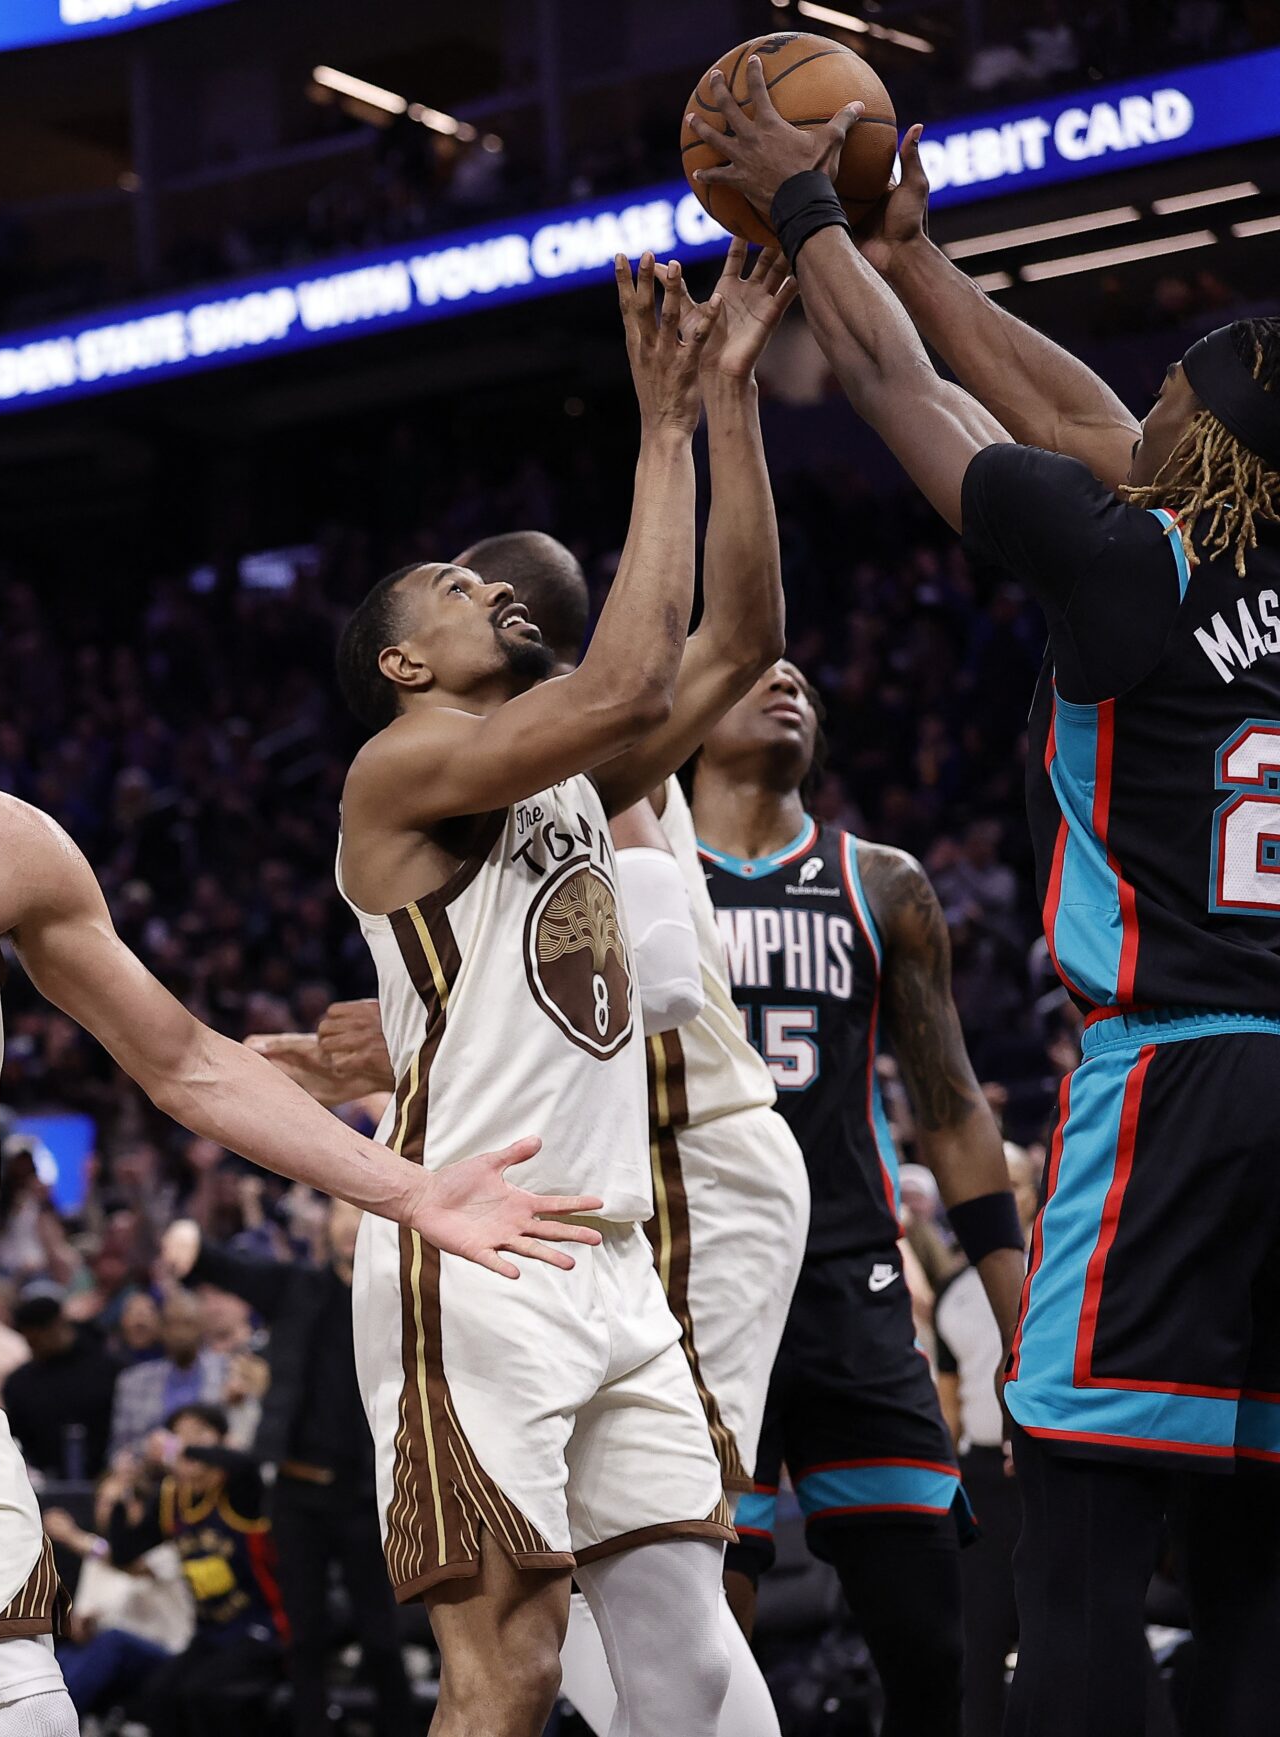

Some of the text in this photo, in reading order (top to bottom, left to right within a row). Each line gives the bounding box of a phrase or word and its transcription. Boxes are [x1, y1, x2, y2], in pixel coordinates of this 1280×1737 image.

[75, 310, 188, 382] STATE
[186, 287, 298, 357] SHOP
[296, 261, 411, 331] WITH
[408, 234, 533, 304] YOUR
[530, 200, 678, 278] CHASE
[919, 113, 1050, 193] DEBIT
[1054, 88, 1195, 162] CARD
[516, 805, 544, 834] The
[715, 907, 853, 1000] MPHIS
[592, 973, 609, 1037] 8
